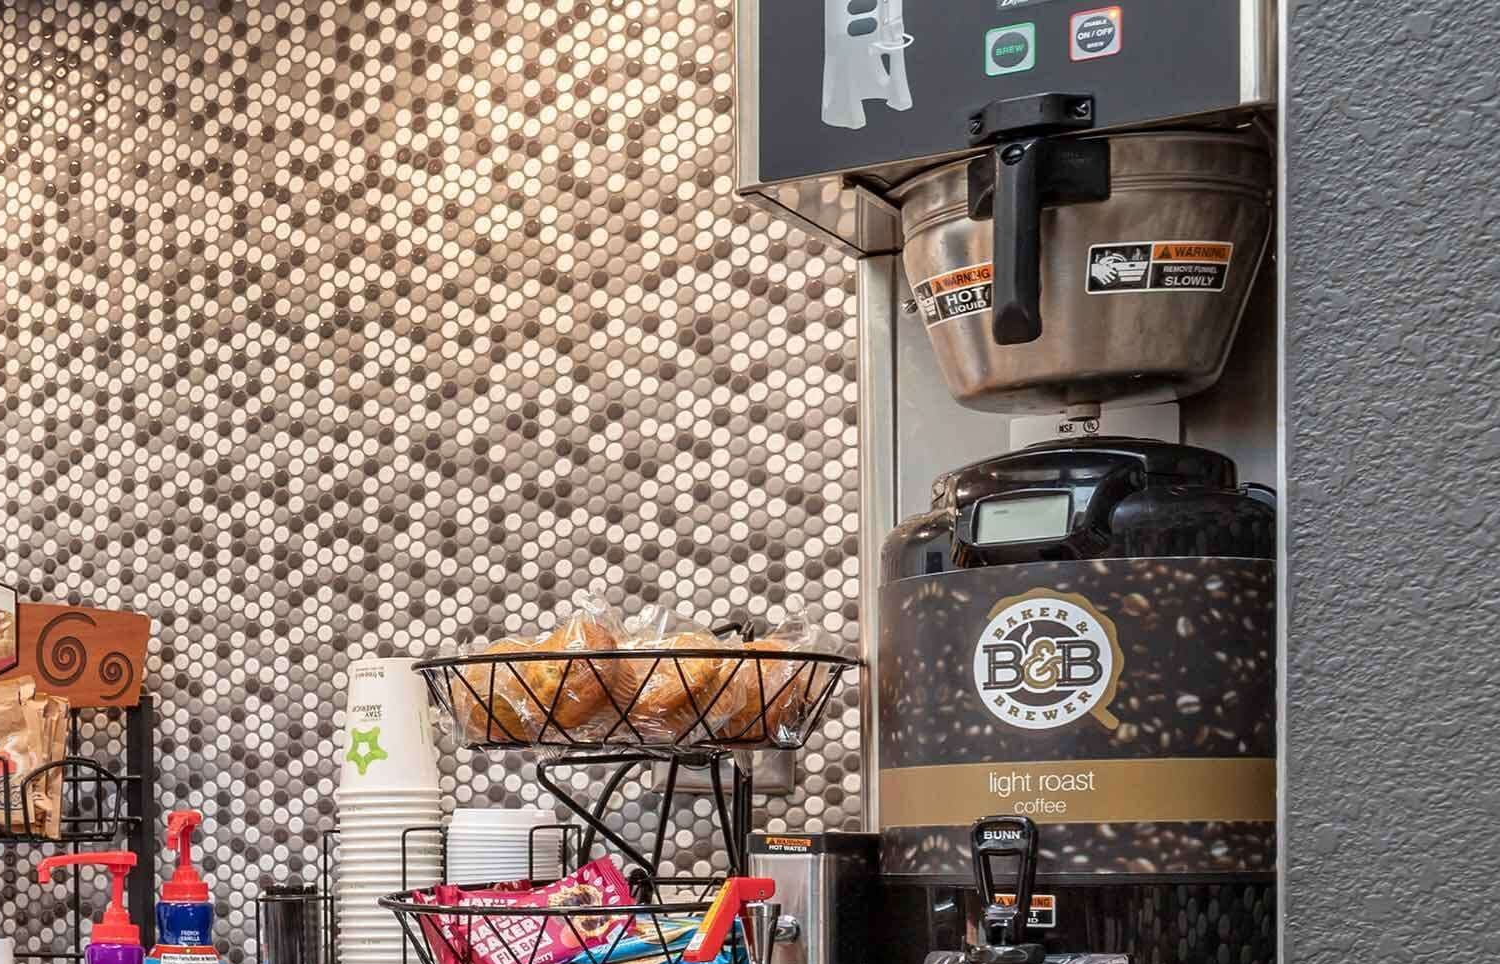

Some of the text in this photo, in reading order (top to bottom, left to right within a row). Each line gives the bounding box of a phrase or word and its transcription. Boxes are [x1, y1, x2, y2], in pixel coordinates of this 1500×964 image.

[1077, 31, 1091, 41] ON
[1096, 27, 1114, 37] OFF
[995, 43, 1025, 56] BREW
[1174, 246, 1227, 259] WARNING
[944, 268, 990, 287] WARNING
[1163, 265, 1194, 273] REMOVE
[1164, 275, 1215, 287] SLOWLY
[946, 286, 986, 306] HOT
[948, 299, 987, 316] LIQUID
[992, 607, 1089, 640] BAKER &
[982, 639, 1103, 691] B&B
[994, 690, 1093, 721] BREWER
[989, 770, 1096, 798] light roast
[1013, 798, 1067, 815] coffee
[983, 830, 1022, 841] BUNN
